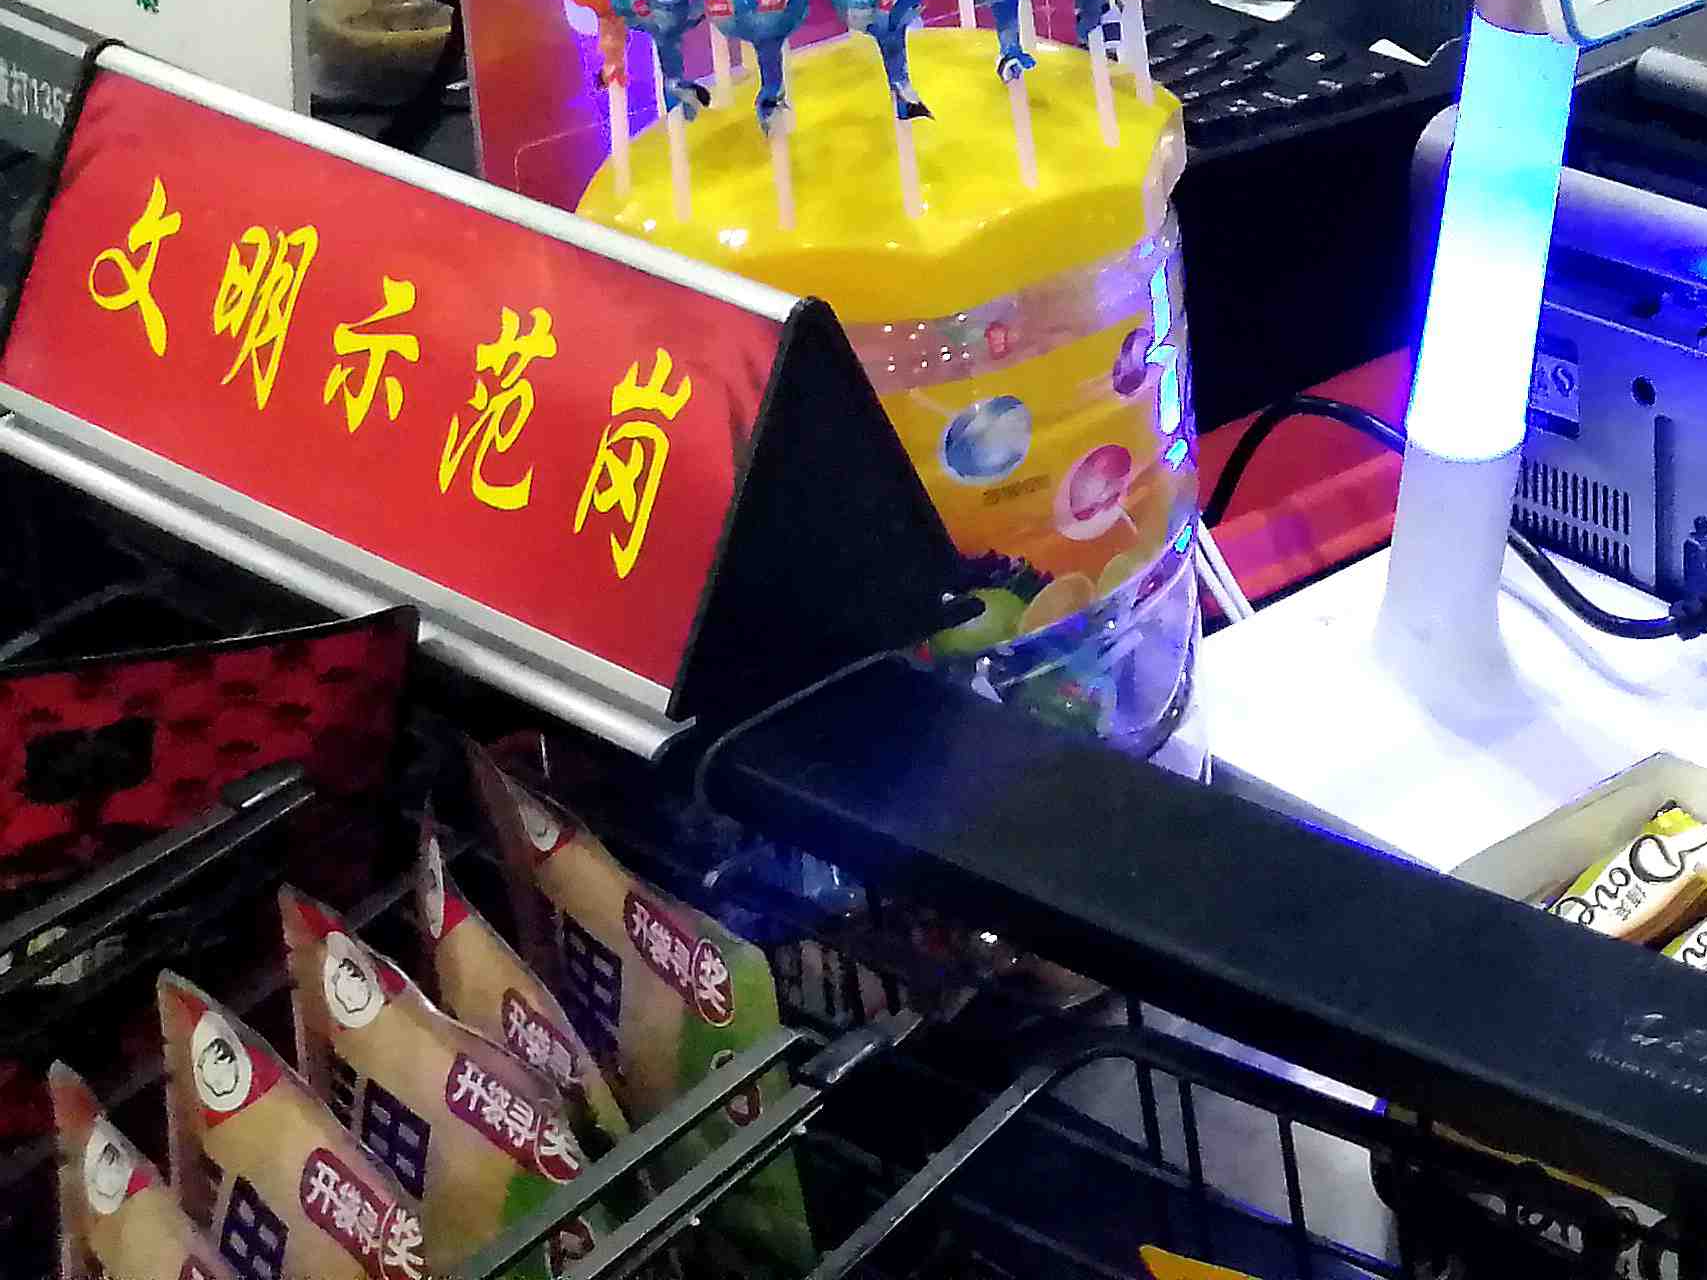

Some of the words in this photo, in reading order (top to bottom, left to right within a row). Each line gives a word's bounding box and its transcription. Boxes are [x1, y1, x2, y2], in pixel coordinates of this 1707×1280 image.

[87, 175, 693, 579] 文明示范岗
